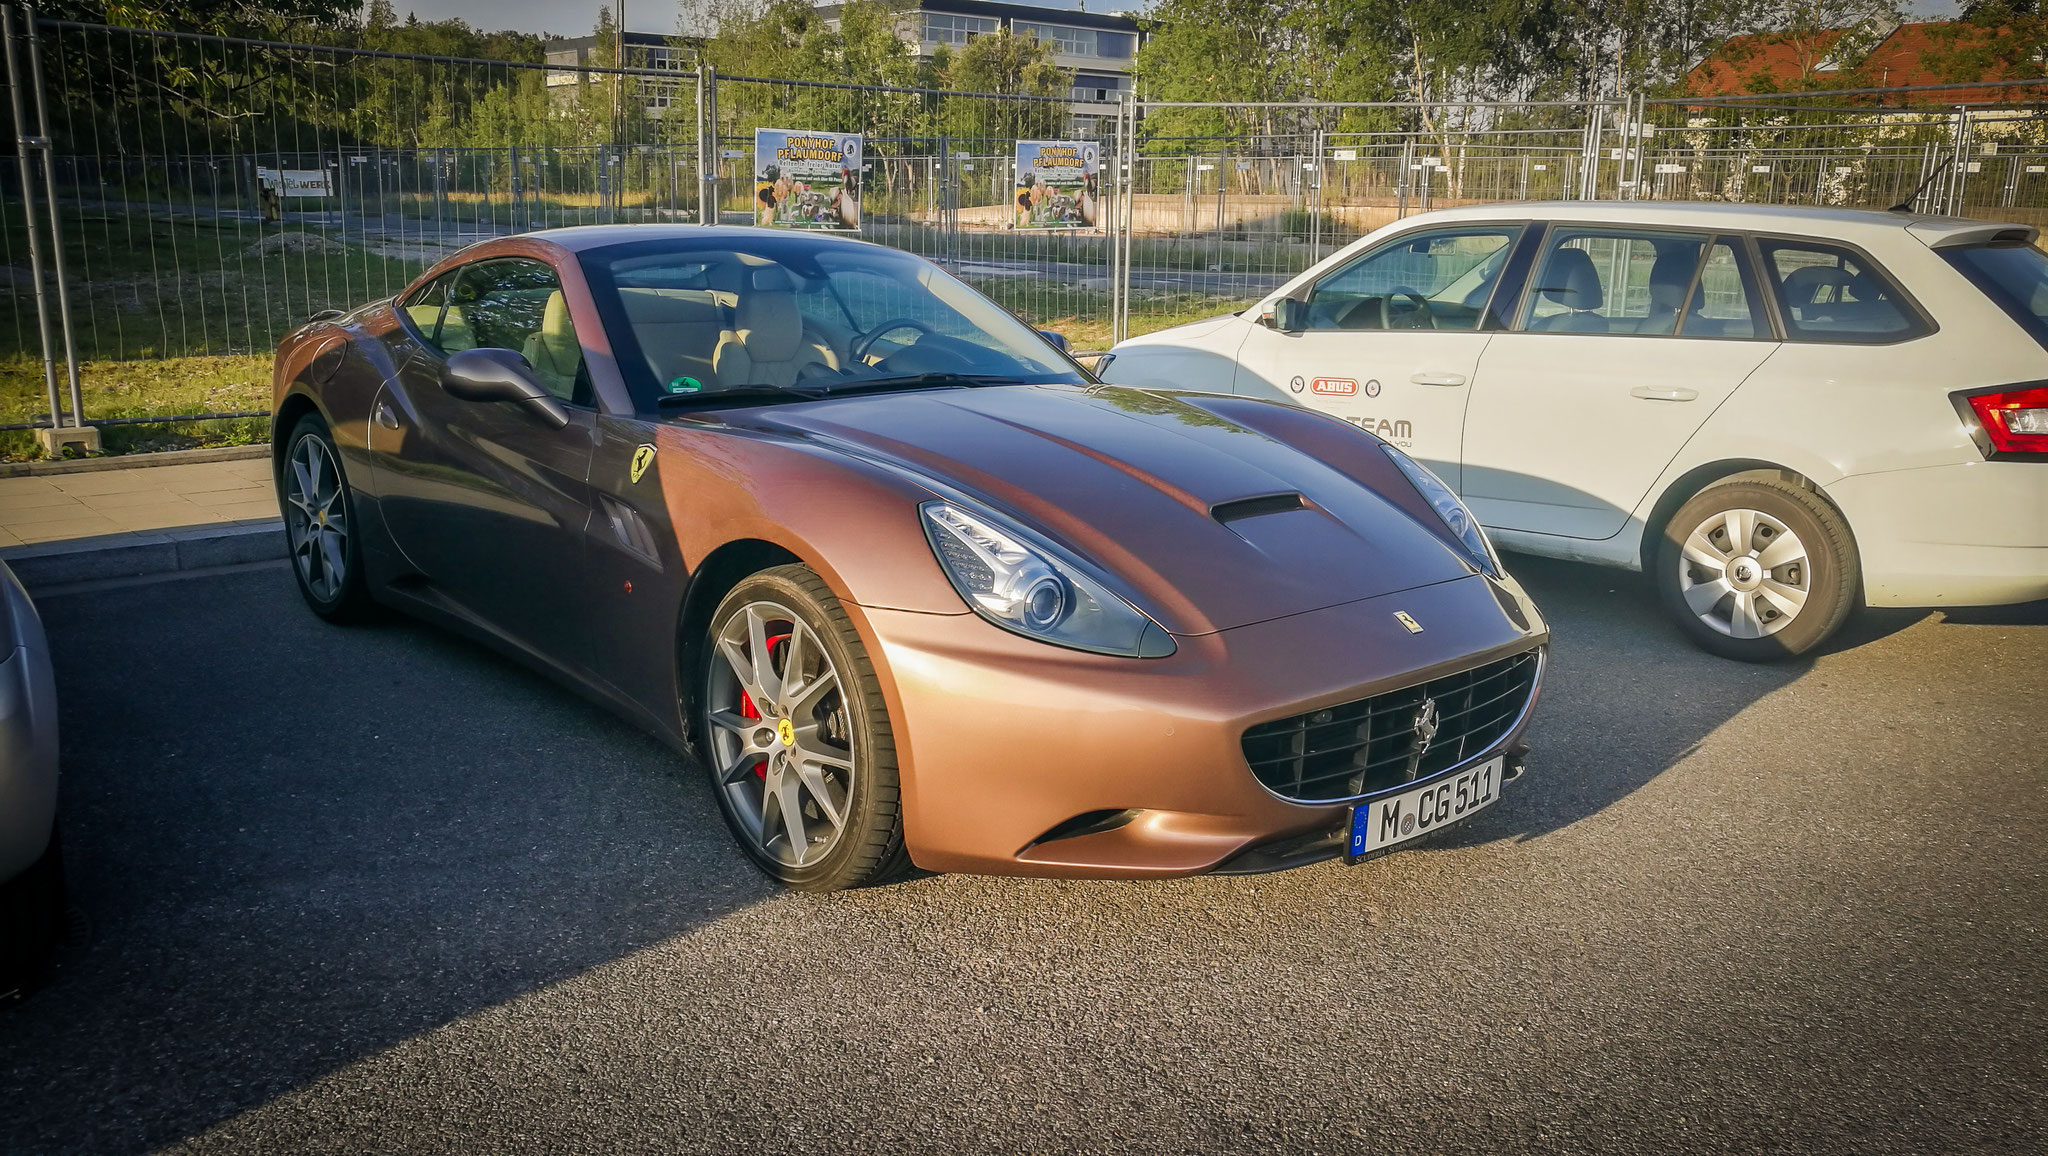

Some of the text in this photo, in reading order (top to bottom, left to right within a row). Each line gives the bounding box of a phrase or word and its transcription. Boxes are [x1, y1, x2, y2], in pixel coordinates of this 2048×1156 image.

[787, 137, 835, 149] PONYHOF
[777, 149, 843, 162] PFLAUMDORF
[1040, 147, 1078, 157] PONYHOF
[1033, 157, 1085, 168] PFLAUMDORF
[680, 378, 690, 387] 4
[1317, 380, 1353, 393] ABUS
[1379, 765, 1492, 843] M CG 511
[1355, 834, 1362, 847] D
